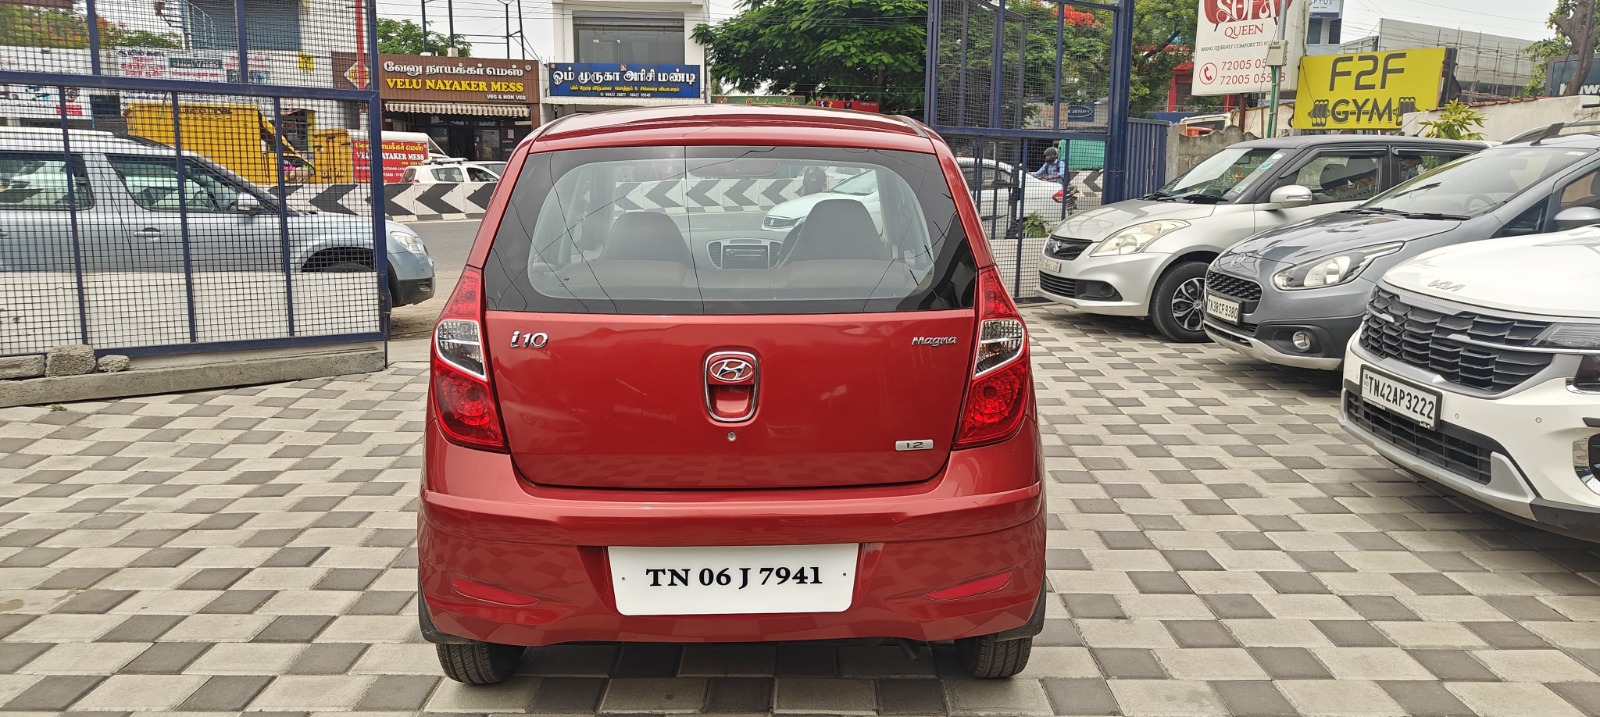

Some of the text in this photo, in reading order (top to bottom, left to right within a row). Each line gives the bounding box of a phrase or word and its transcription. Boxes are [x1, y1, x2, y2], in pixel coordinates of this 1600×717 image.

[1224, 24, 1264, 39] QUEEN
[384, 61, 524, 76] வேலு நாயக்கர் மெஸ்
[1221, 60, 1252, 71] 72005
[1329, 52, 1407, 91] F2F
[553, 66, 696, 85] ஓம் முருகா அரிசி மண்டி
[1220, 72, 1286, 85] 72005 0558
[386, 78, 524, 93] VELU NAYAKER MESS
[1331, 97, 1393, 123] GYM
[382, 152, 407, 160] AYAKER
[511, 330, 549, 348] i10
[911, 336, 957, 347] Magna
[1368, 376, 1434, 420] TN42AP3222
[906, 441, 924, 449] 1.2
[646, 566, 823, 590] TN 06 J 7941
